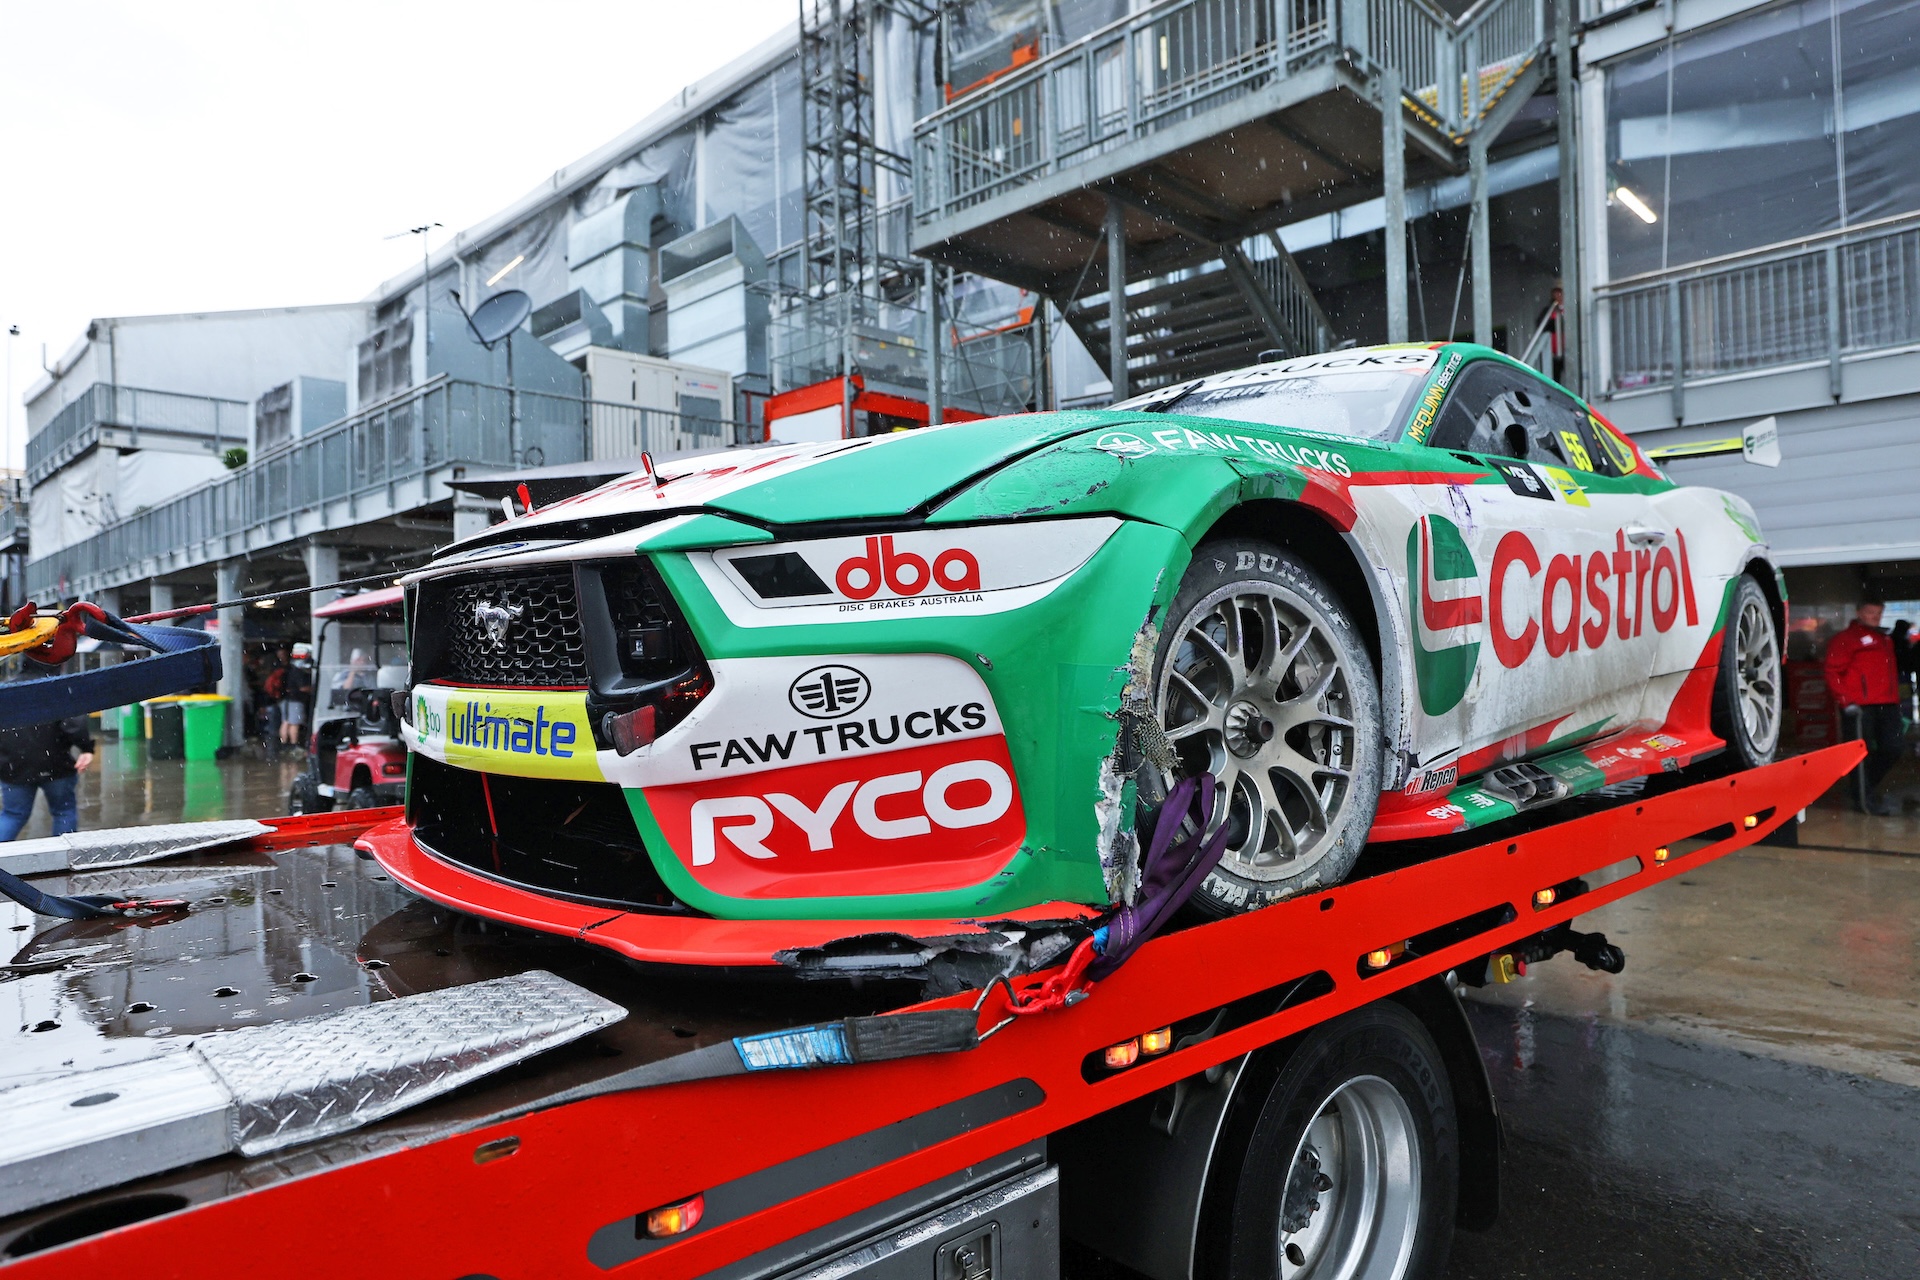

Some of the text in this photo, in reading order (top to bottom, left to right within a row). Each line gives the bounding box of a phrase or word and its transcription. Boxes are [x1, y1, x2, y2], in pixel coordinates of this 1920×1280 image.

[1151, 429, 1241, 452] FAW
[1233, 435, 1353, 479] TRUCKS
[1560, 430, 1594, 473] 55
[835, 535, 981, 601] dba
[839, 594, 984, 613] DISC BRAKES AUSTRALIA
[1488, 527, 1699, 669] Castrol
[429, 708, 441, 739] bp
[451, 701, 576, 759] ultimate
[689, 702, 987, 771] FAW TRUCKS
[690, 759, 1013, 867] RYCO
